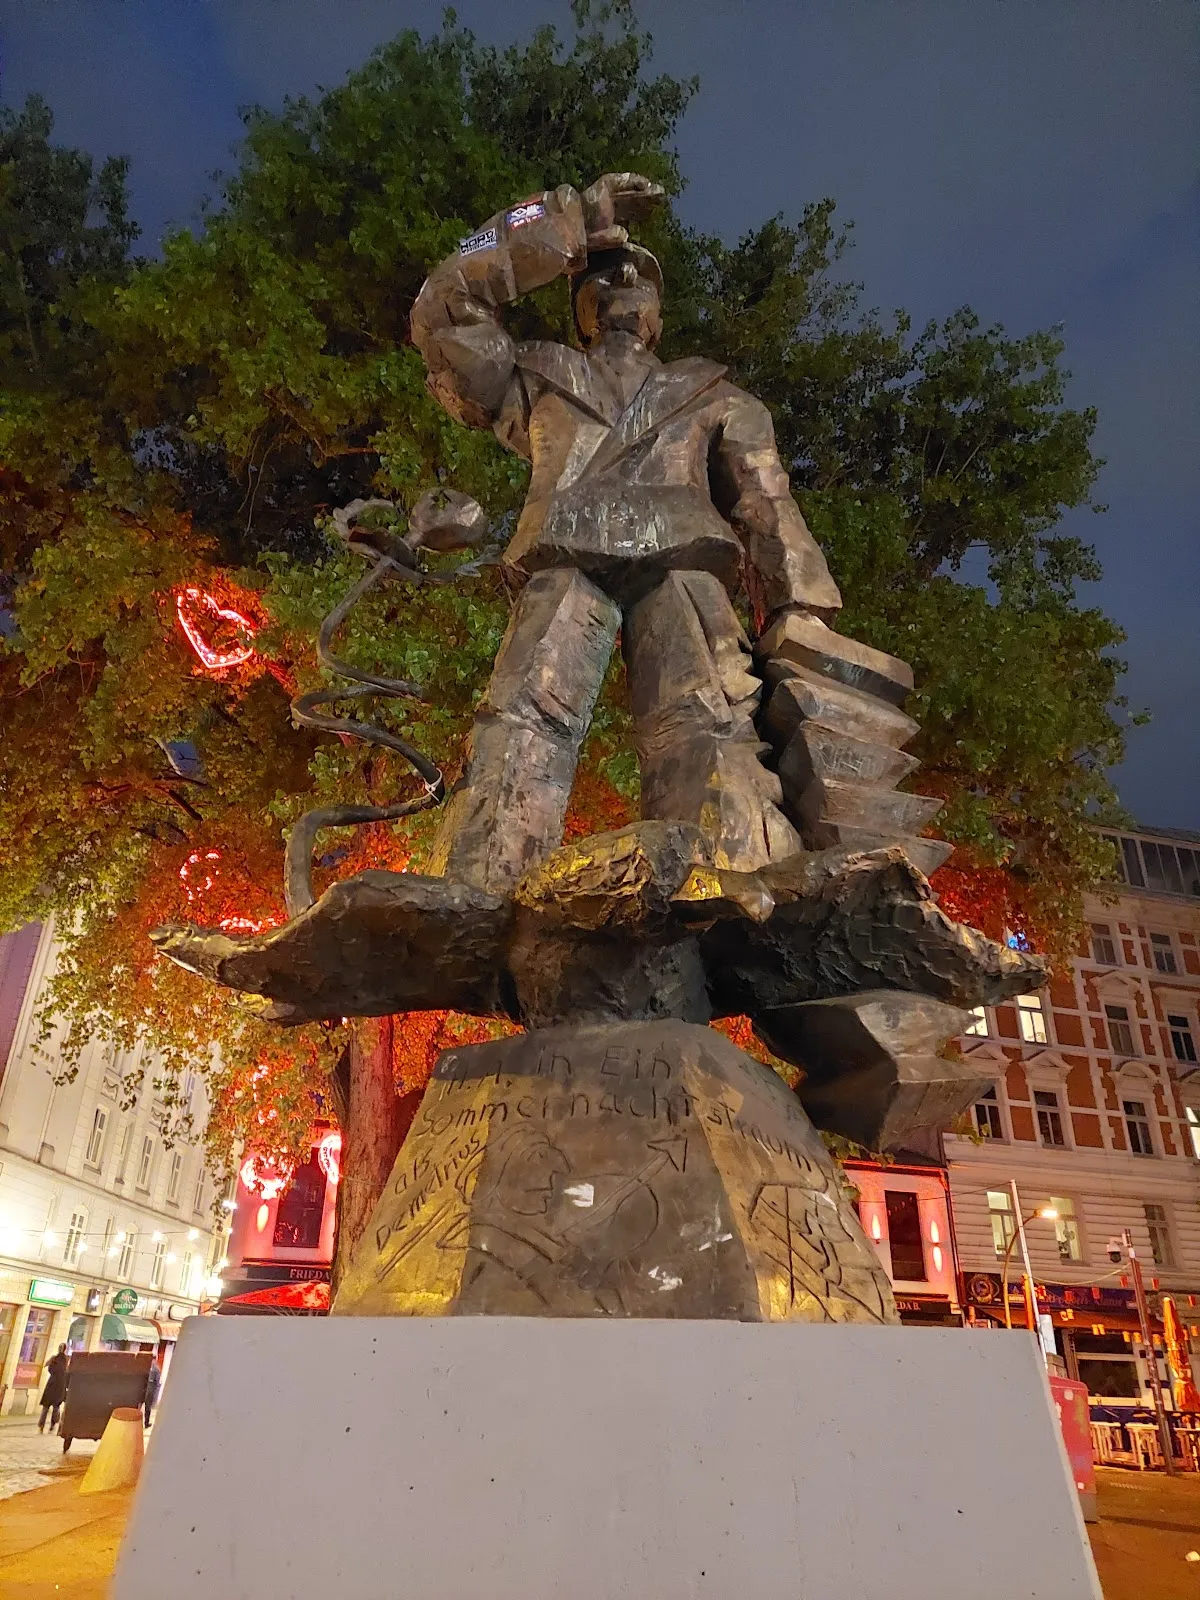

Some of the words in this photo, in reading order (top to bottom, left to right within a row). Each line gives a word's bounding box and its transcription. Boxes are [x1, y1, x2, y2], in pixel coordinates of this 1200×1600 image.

[601, 1042, 672, 1079] Ein
[395, 1149, 432, 1195] als
[290, 1269, 330, 1279] FRIEDA
